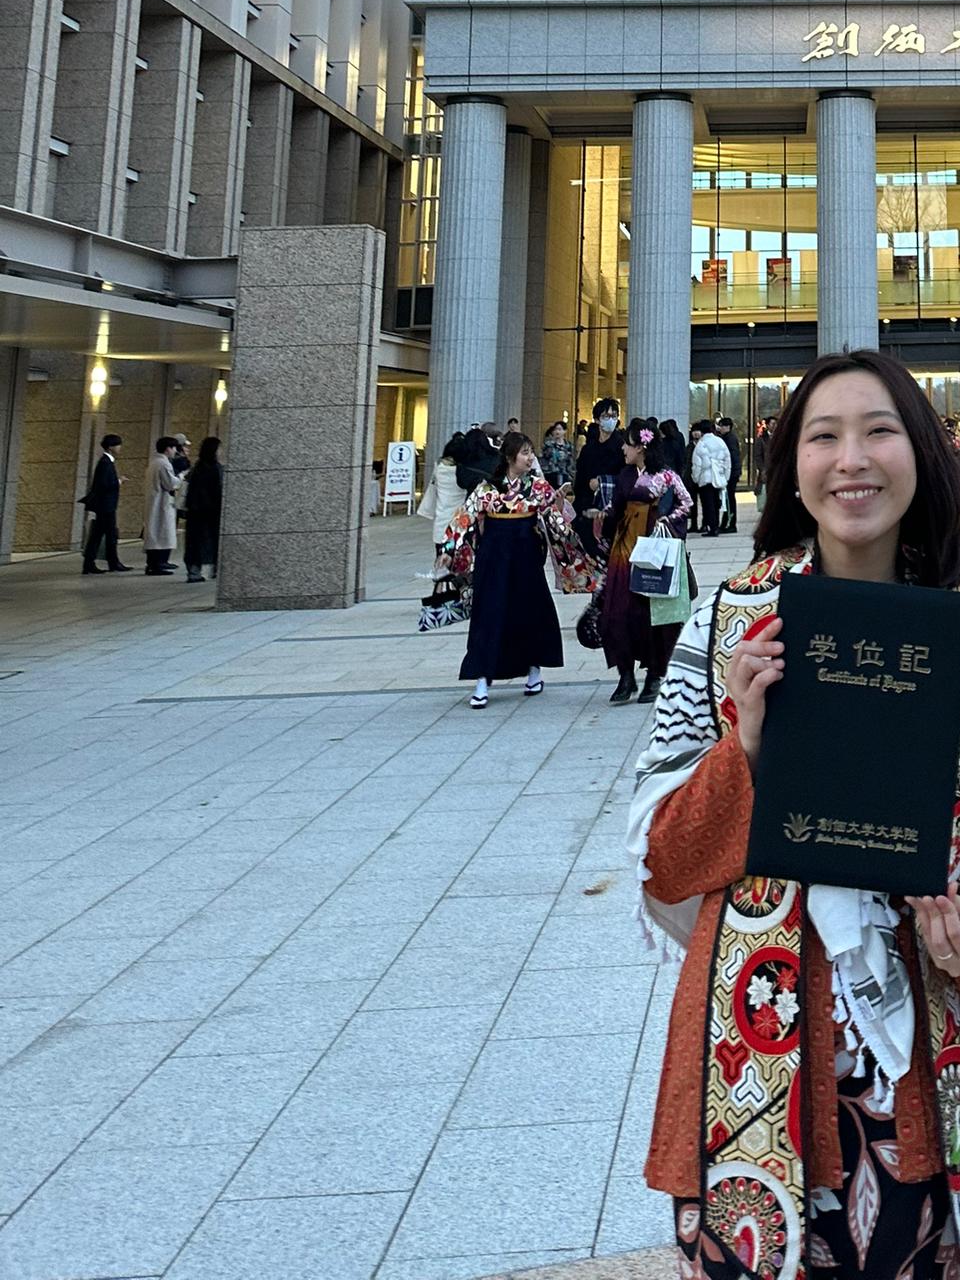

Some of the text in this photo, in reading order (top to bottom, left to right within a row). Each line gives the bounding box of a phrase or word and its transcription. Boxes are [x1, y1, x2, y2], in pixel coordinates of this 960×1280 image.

[805, 634, 931, 675] 学位記
[817, 817, 919, 842] 創価大学大学院
